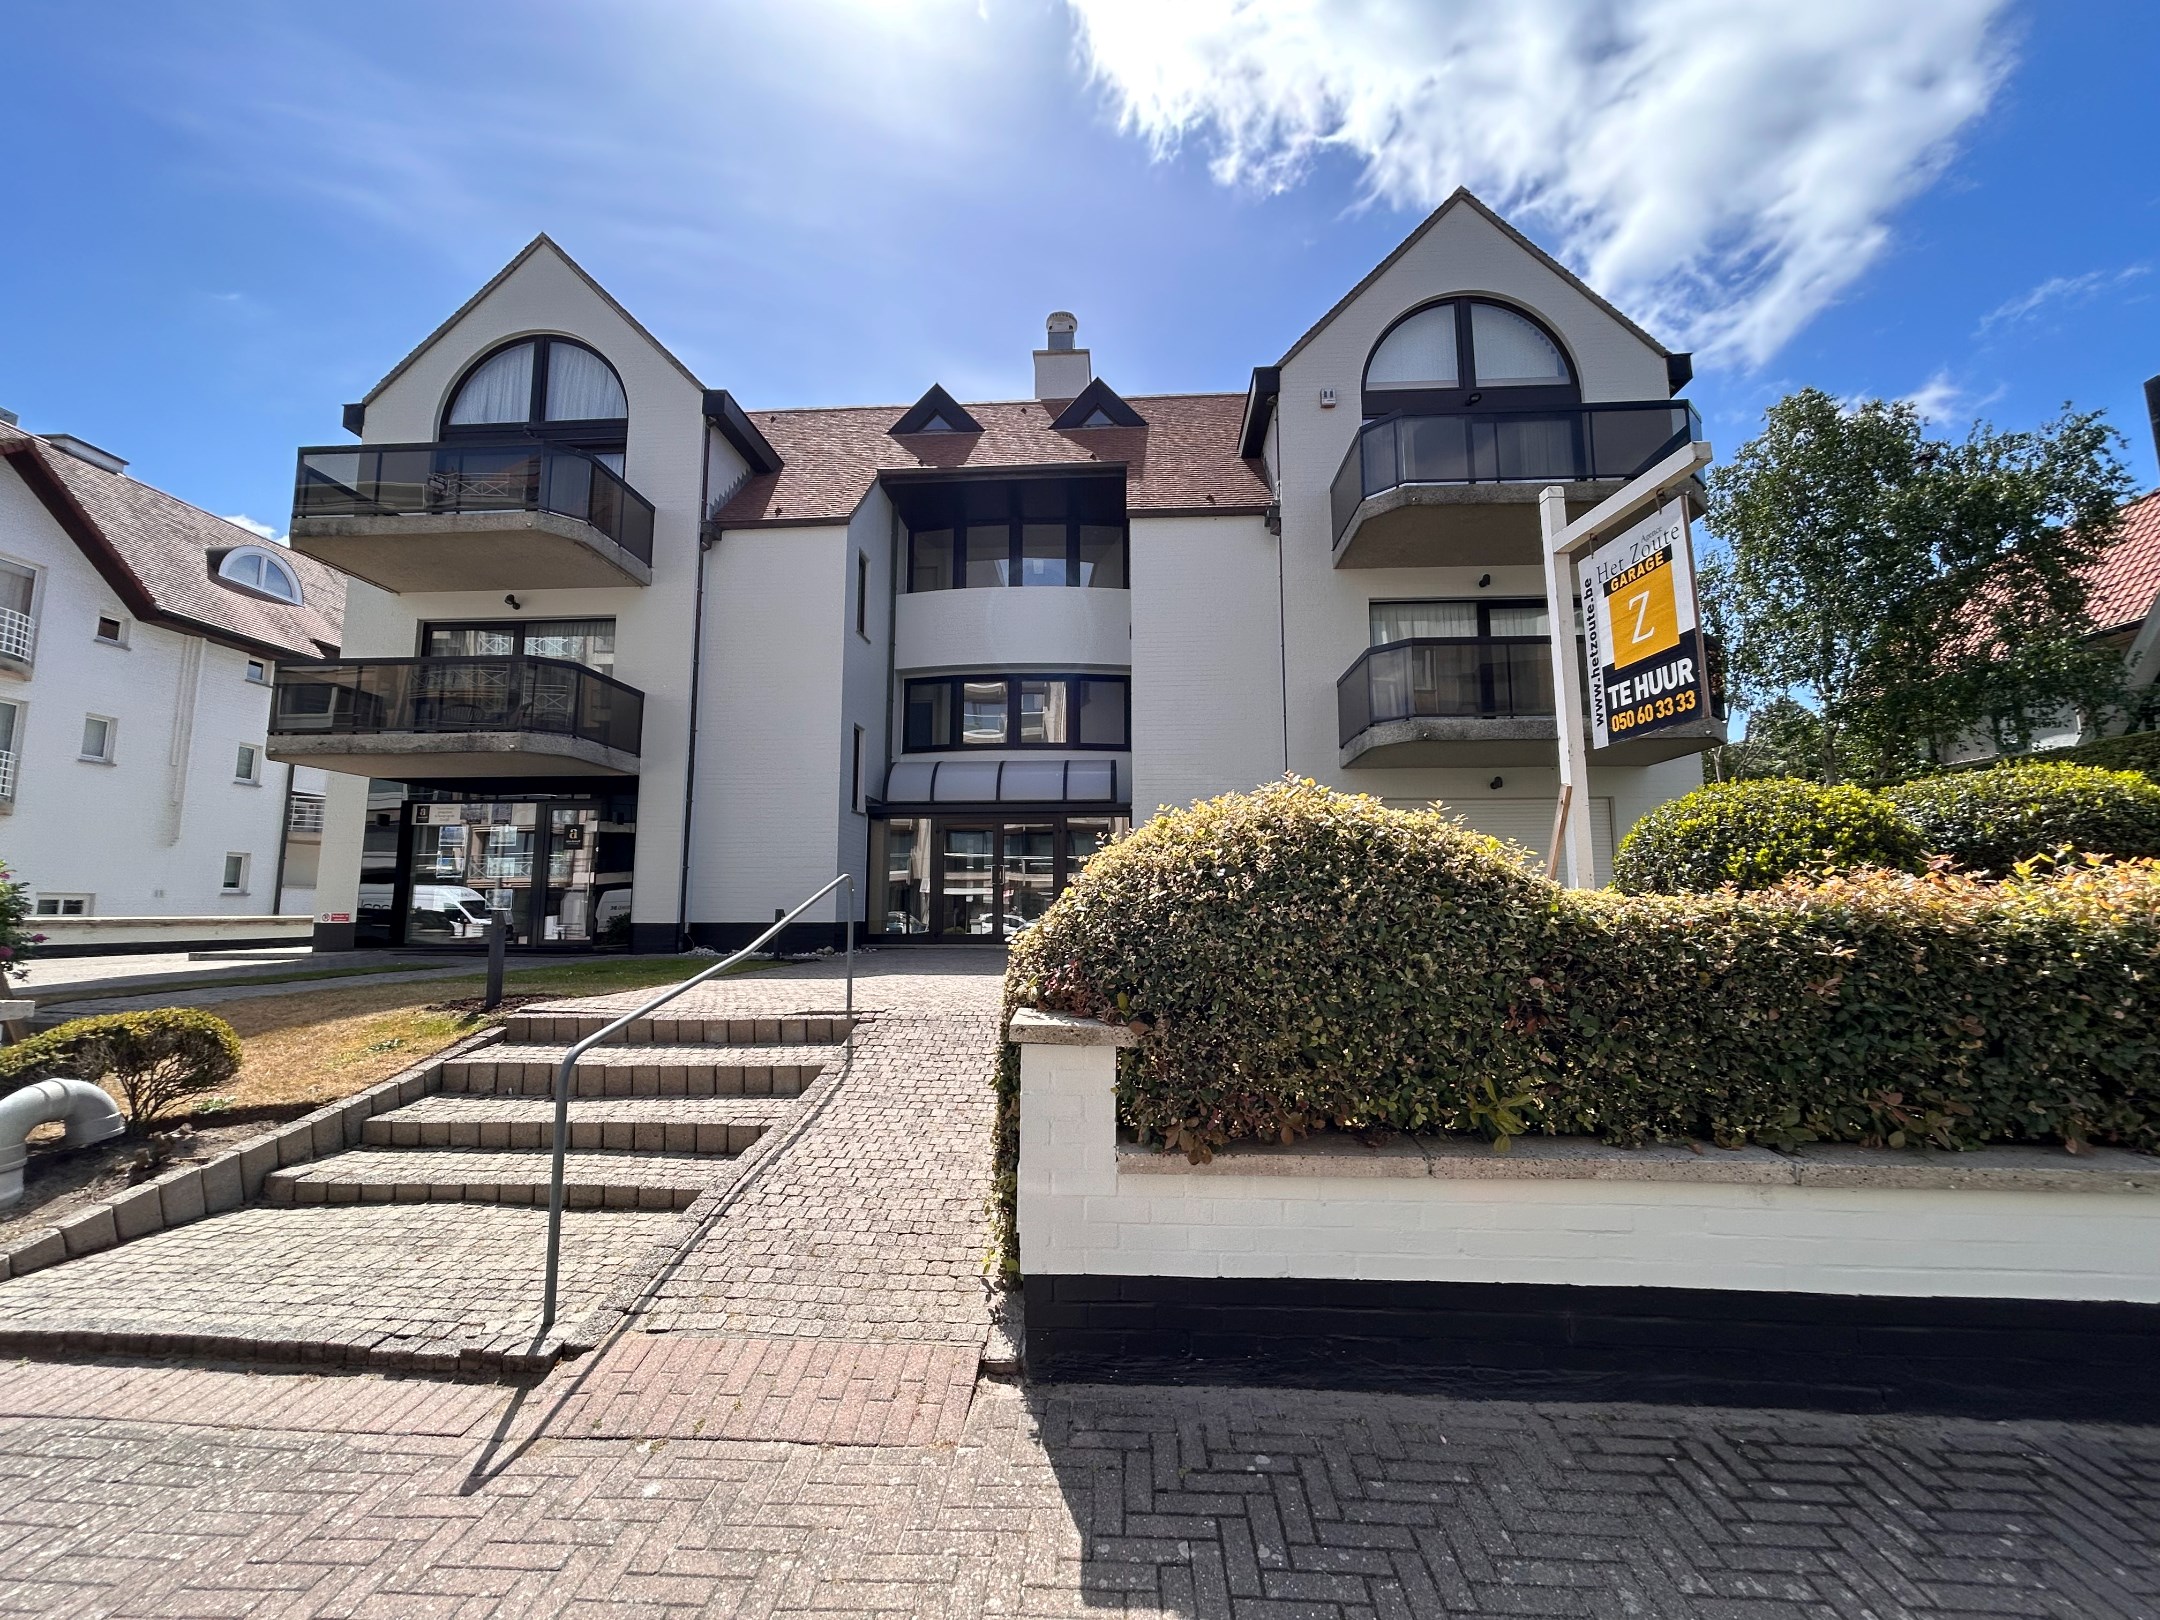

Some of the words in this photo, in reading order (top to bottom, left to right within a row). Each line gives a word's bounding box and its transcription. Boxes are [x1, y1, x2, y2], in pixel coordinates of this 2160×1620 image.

[1596, 558, 1624, 584] Het
[1629, 526, 1679, 564] Zoute
[1641, 526, 1662, 542] Agence
[1610, 551, 1664, 592] GARAGE
[1628, 590, 1655, 644] Z
[1584, 577, 1604, 727] www.hetzoute.be
[1607, 679, 1632, 710] TE
[1634, 657, 1695, 701] HUUR
[1611, 709, 1634, 732] 050
[1637, 705, 1653, 725] 60
[1655, 696, 1674, 719] 33
[1675, 690, 1696, 713] 33
